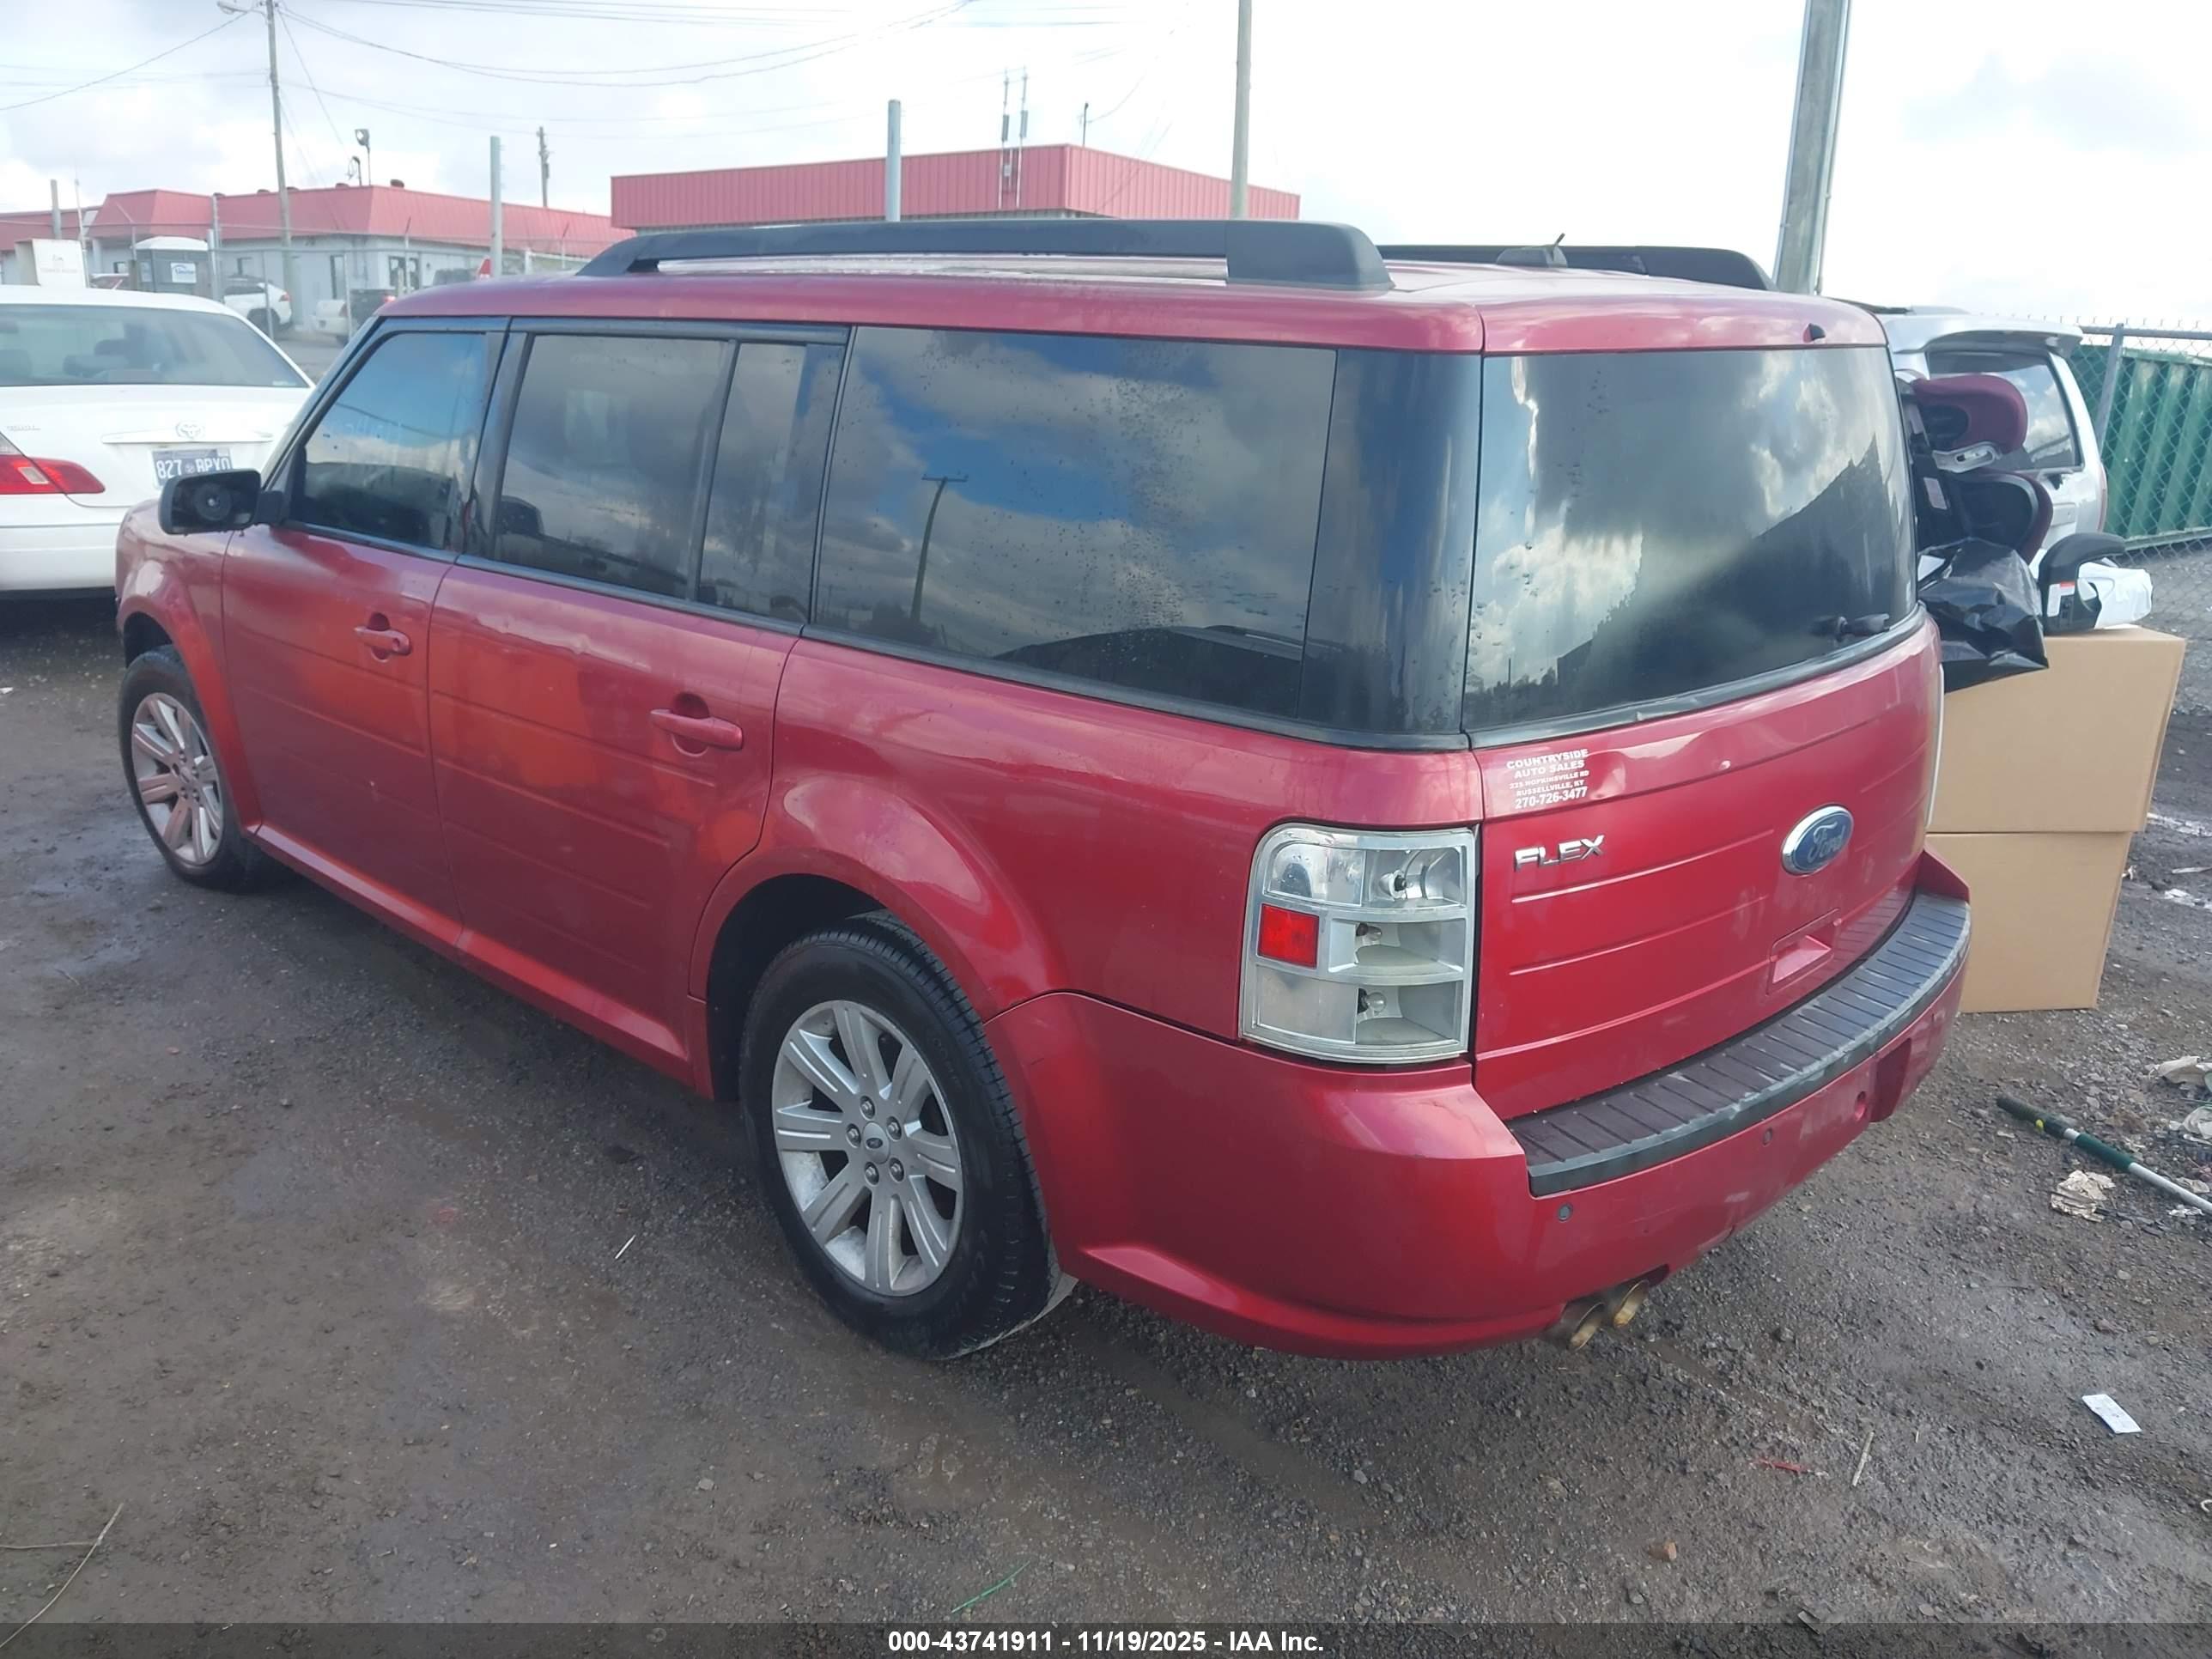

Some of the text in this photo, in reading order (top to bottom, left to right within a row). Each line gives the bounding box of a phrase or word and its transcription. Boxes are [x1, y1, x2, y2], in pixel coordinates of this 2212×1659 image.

[156, 459, 182, 479] 827
[1506, 748, 1589, 769] COUNTRYSIDE
[1514, 760, 1585, 778] AUTO SALES
[1525, 771, 1578, 787] HOPKINSVILLE
[1515, 786, 1588, 809] 270-726-3477
[1516, 781, 1573, 797] RUSSELLVILLE,
[1514, 834, 1605, 872] FLEX
